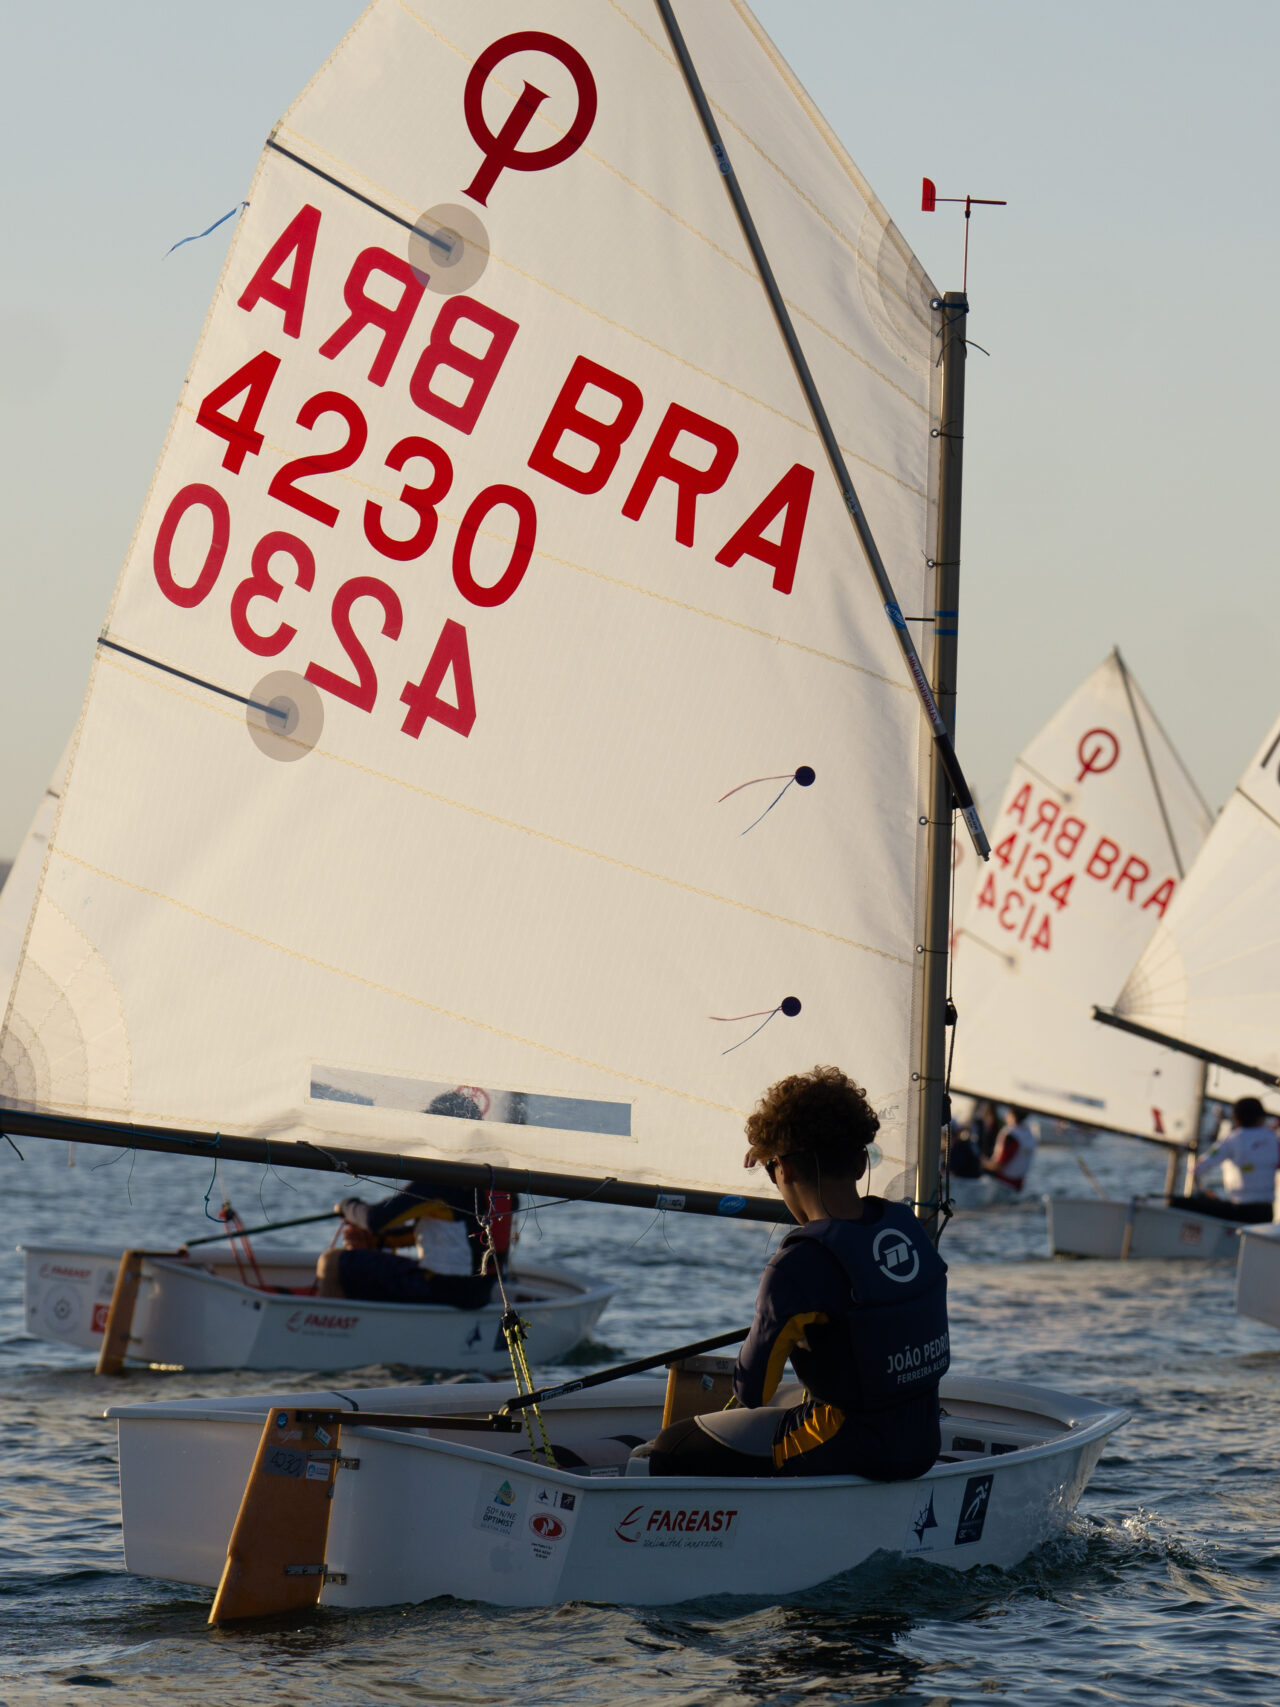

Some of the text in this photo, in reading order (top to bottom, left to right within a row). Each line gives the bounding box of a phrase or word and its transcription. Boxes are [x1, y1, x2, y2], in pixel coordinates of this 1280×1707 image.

[195, 350, 537, 608] 4230
[527, 355, 815, 595] BRA
[994, 832, 1075, 912] 4134
[1084, 836, 1176, 920] BRA
[887, 1345, 921, 1374] JOÃO
[897, 1365, 932, 1385] FERREIRA
[482, 1513, 515, 1529] OPTIMIST
[646, 1510, 738, 1532] FAREAST
